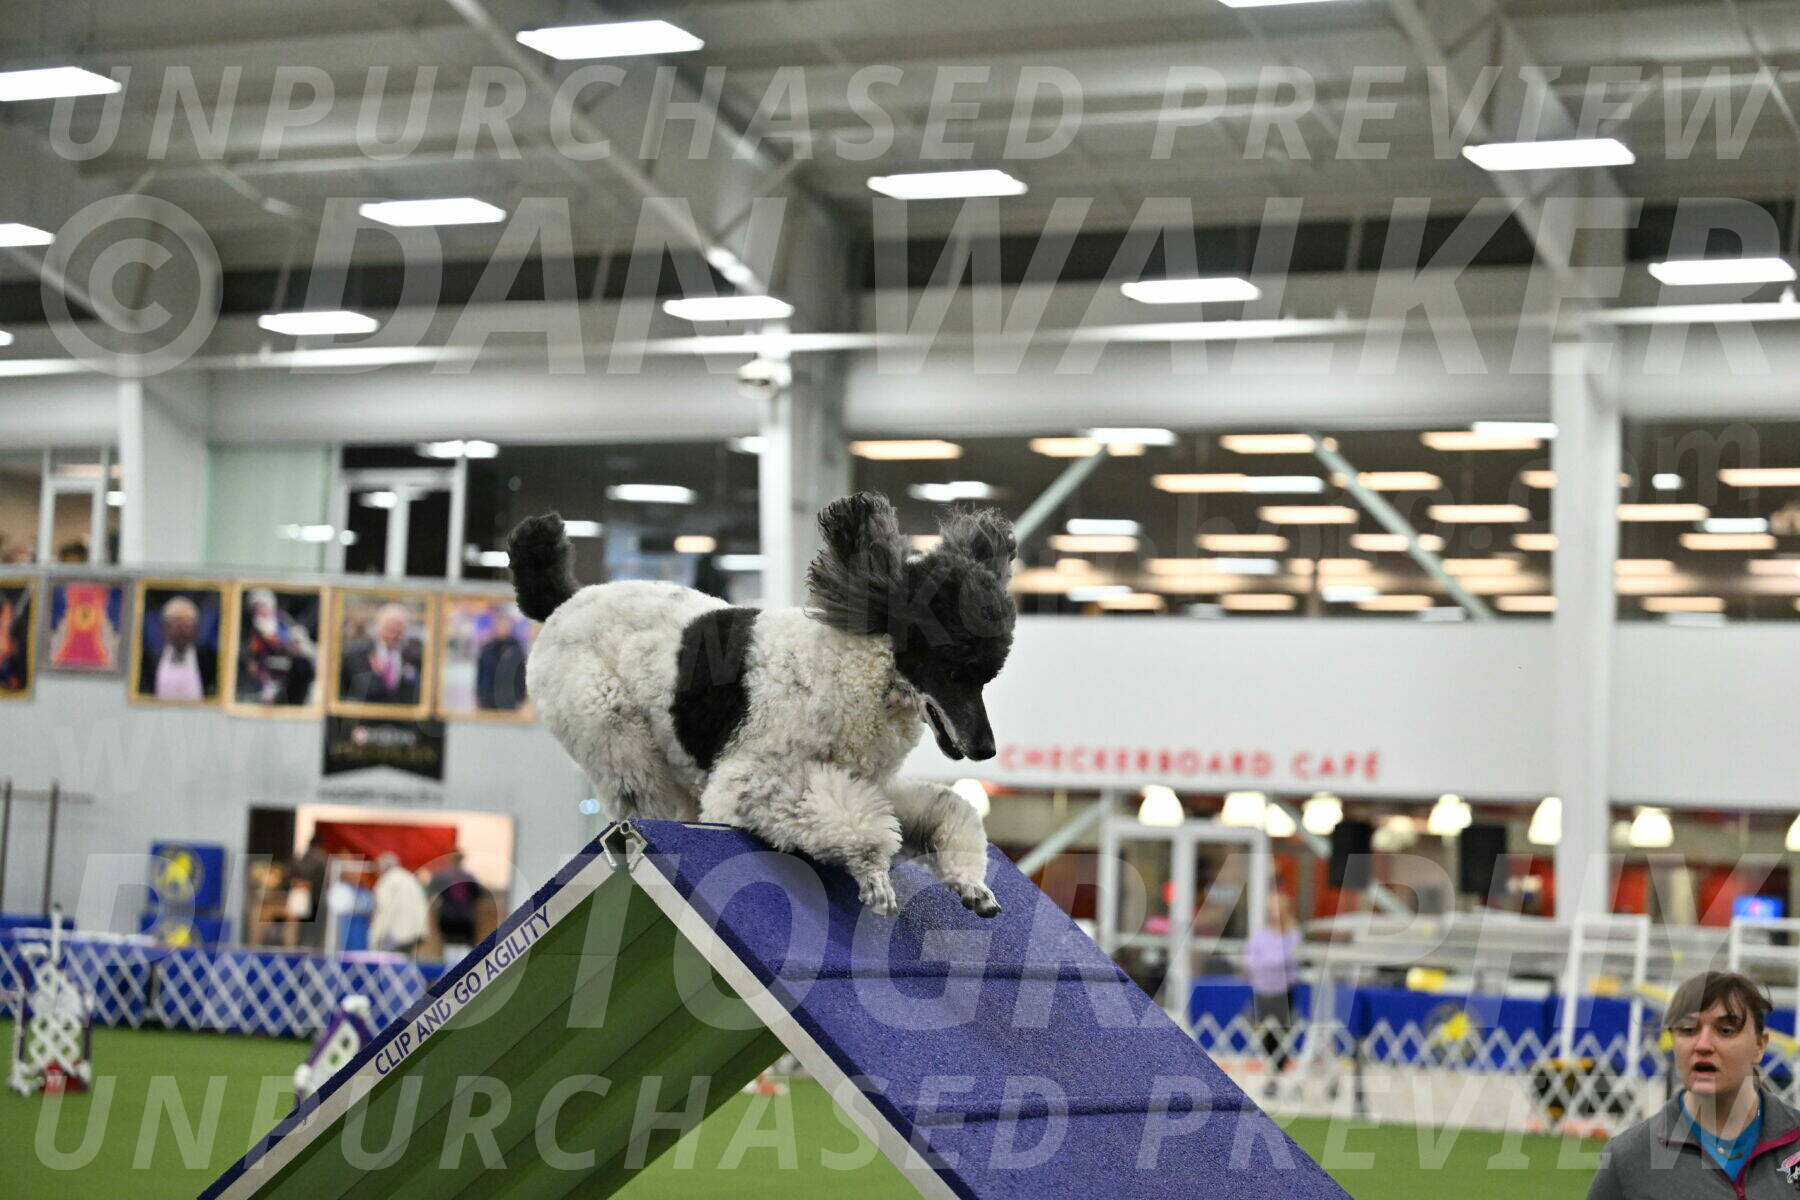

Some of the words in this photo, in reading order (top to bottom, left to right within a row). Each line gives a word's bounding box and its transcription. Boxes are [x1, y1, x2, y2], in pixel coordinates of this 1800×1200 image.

[999, 745, 1273, 776] CHECKERBOARD
[375, 1032, 411, 1075] CLIP
[416, 999, 451, 1043] AND
[454, 971, 482, 1005] GO
[485, 906, 551, 972] AGILITY
